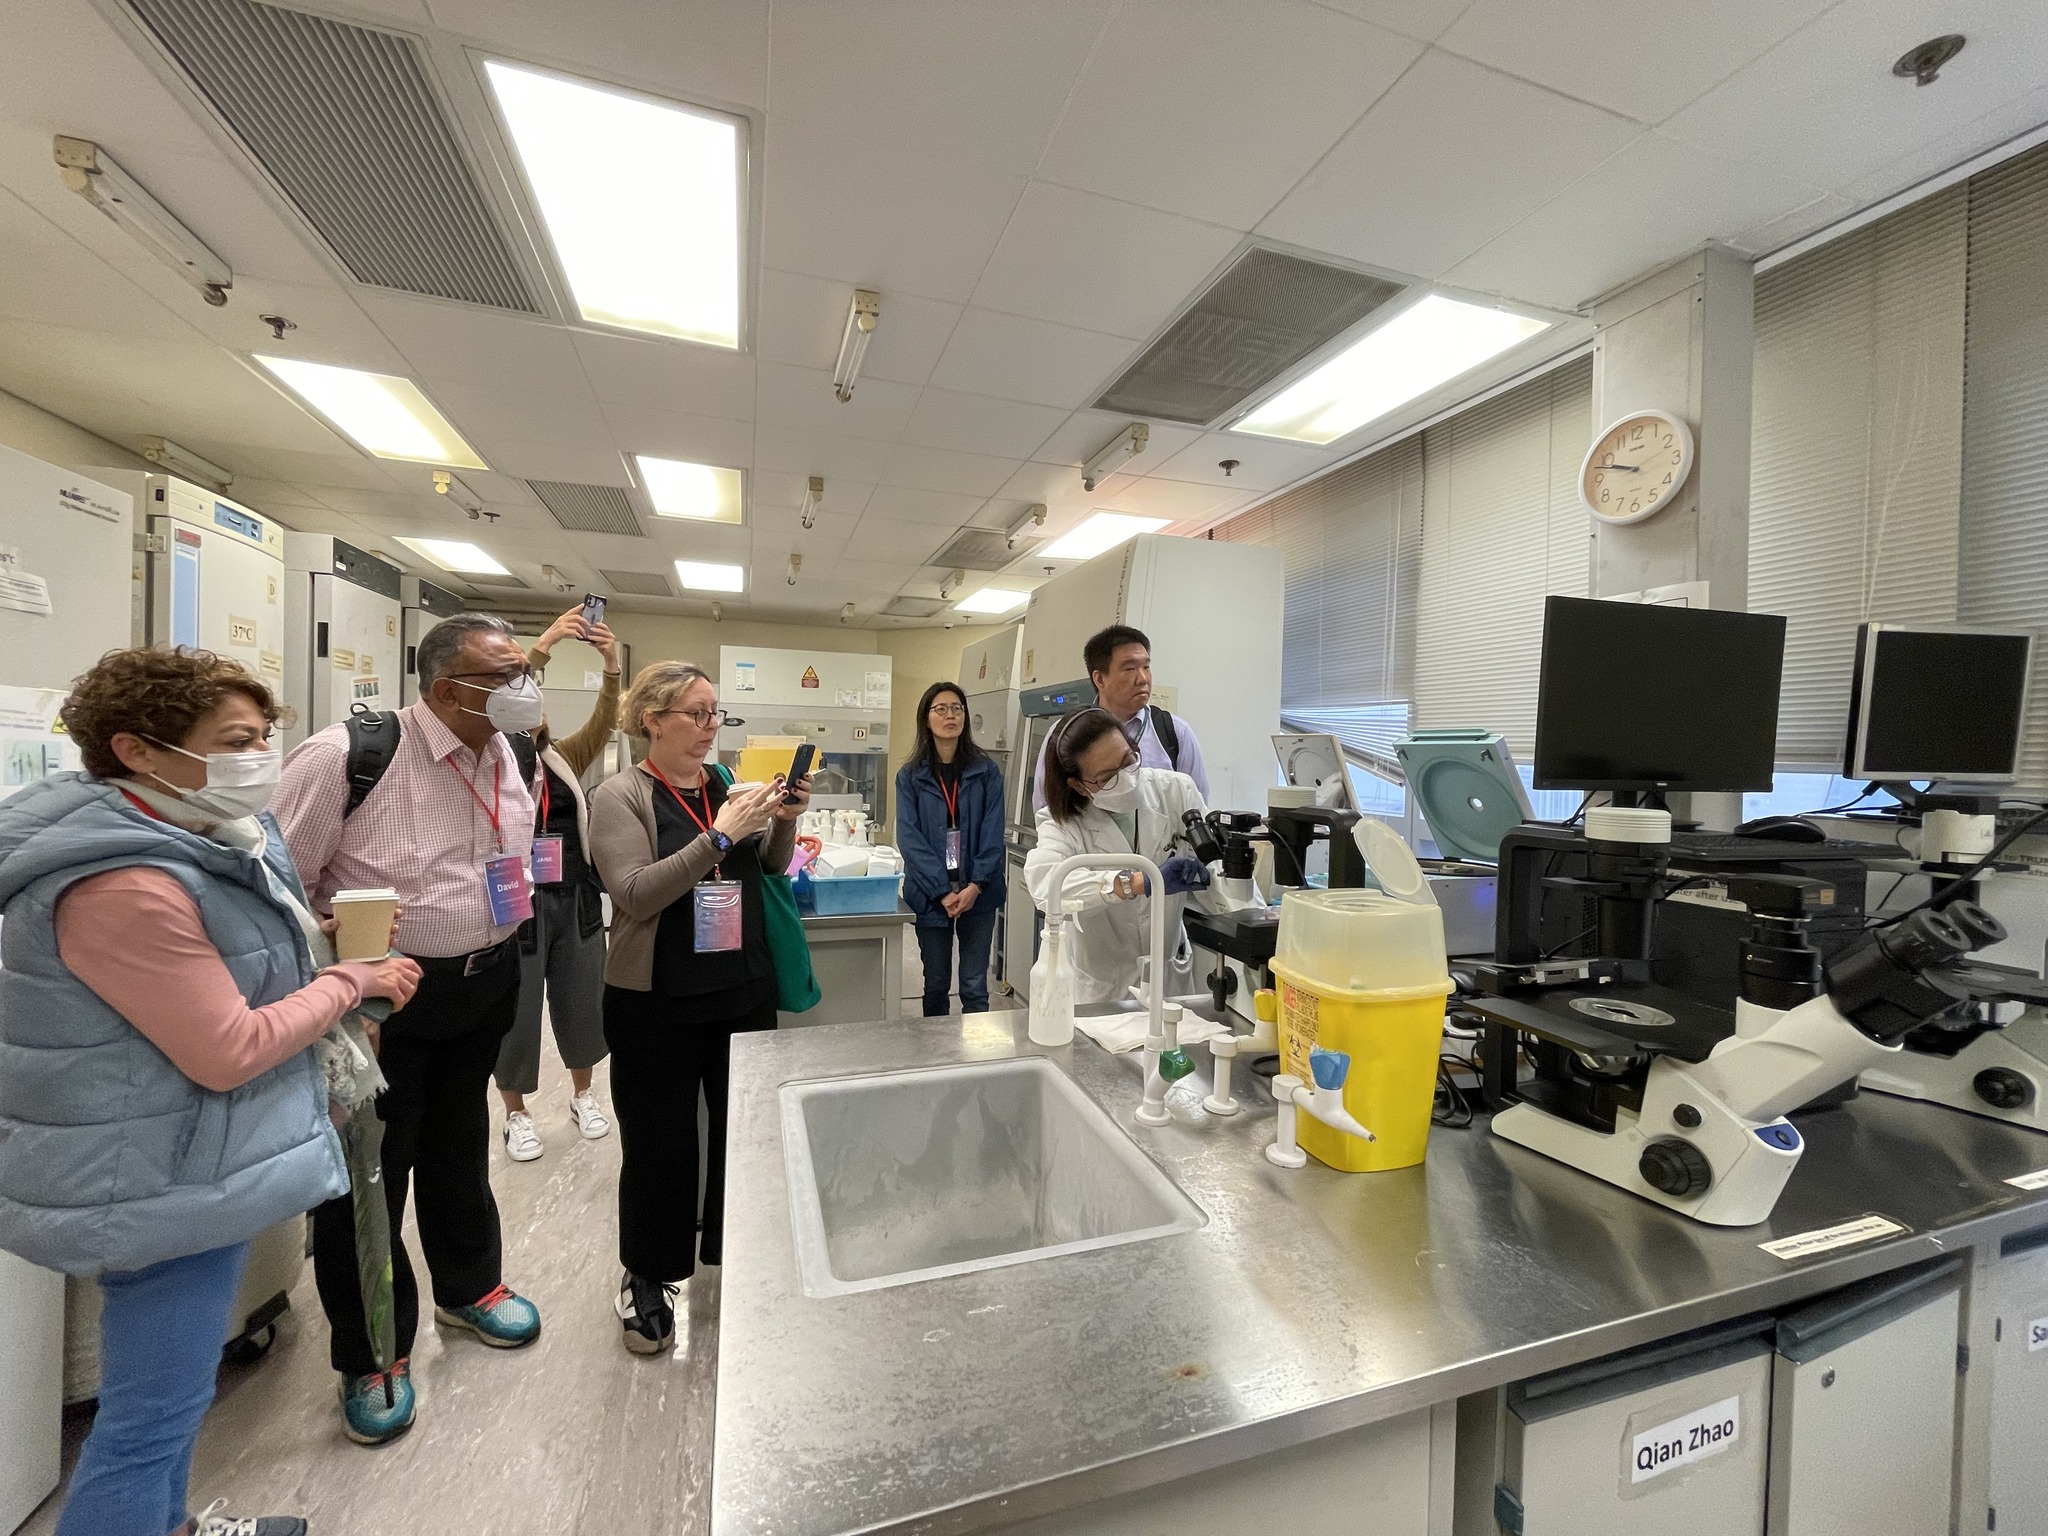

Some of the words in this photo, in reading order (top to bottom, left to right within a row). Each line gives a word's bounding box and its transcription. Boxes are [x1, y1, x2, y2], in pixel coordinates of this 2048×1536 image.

[1631, 425, 1644, 440] 12
[1654, 423, 1659, 438] 1
[1616, 434, 1626, 450] 11
[1662, 433, 1673, 449] 2
[1601, 452, 1615, 467] 10
[1671, 449, 1682, 465] 3
[1594, 473, 1605, 488] 9
[1661, 471, 1672, 485] 4
[1601, 488, 1611, 503] 8
[1647, 488, 1658, 503] 5
[1615, 497, 1625, 512] 7
[1630, 496, 1640, 513] 6
[856, 729, 864, 738] D
[496, 880, 519, 893] David
[1695, 890, 1718, 901] after
[1637, 1439, 1683, 1471] Qian
[1688, 1419, 1734, 1451] Zhao
